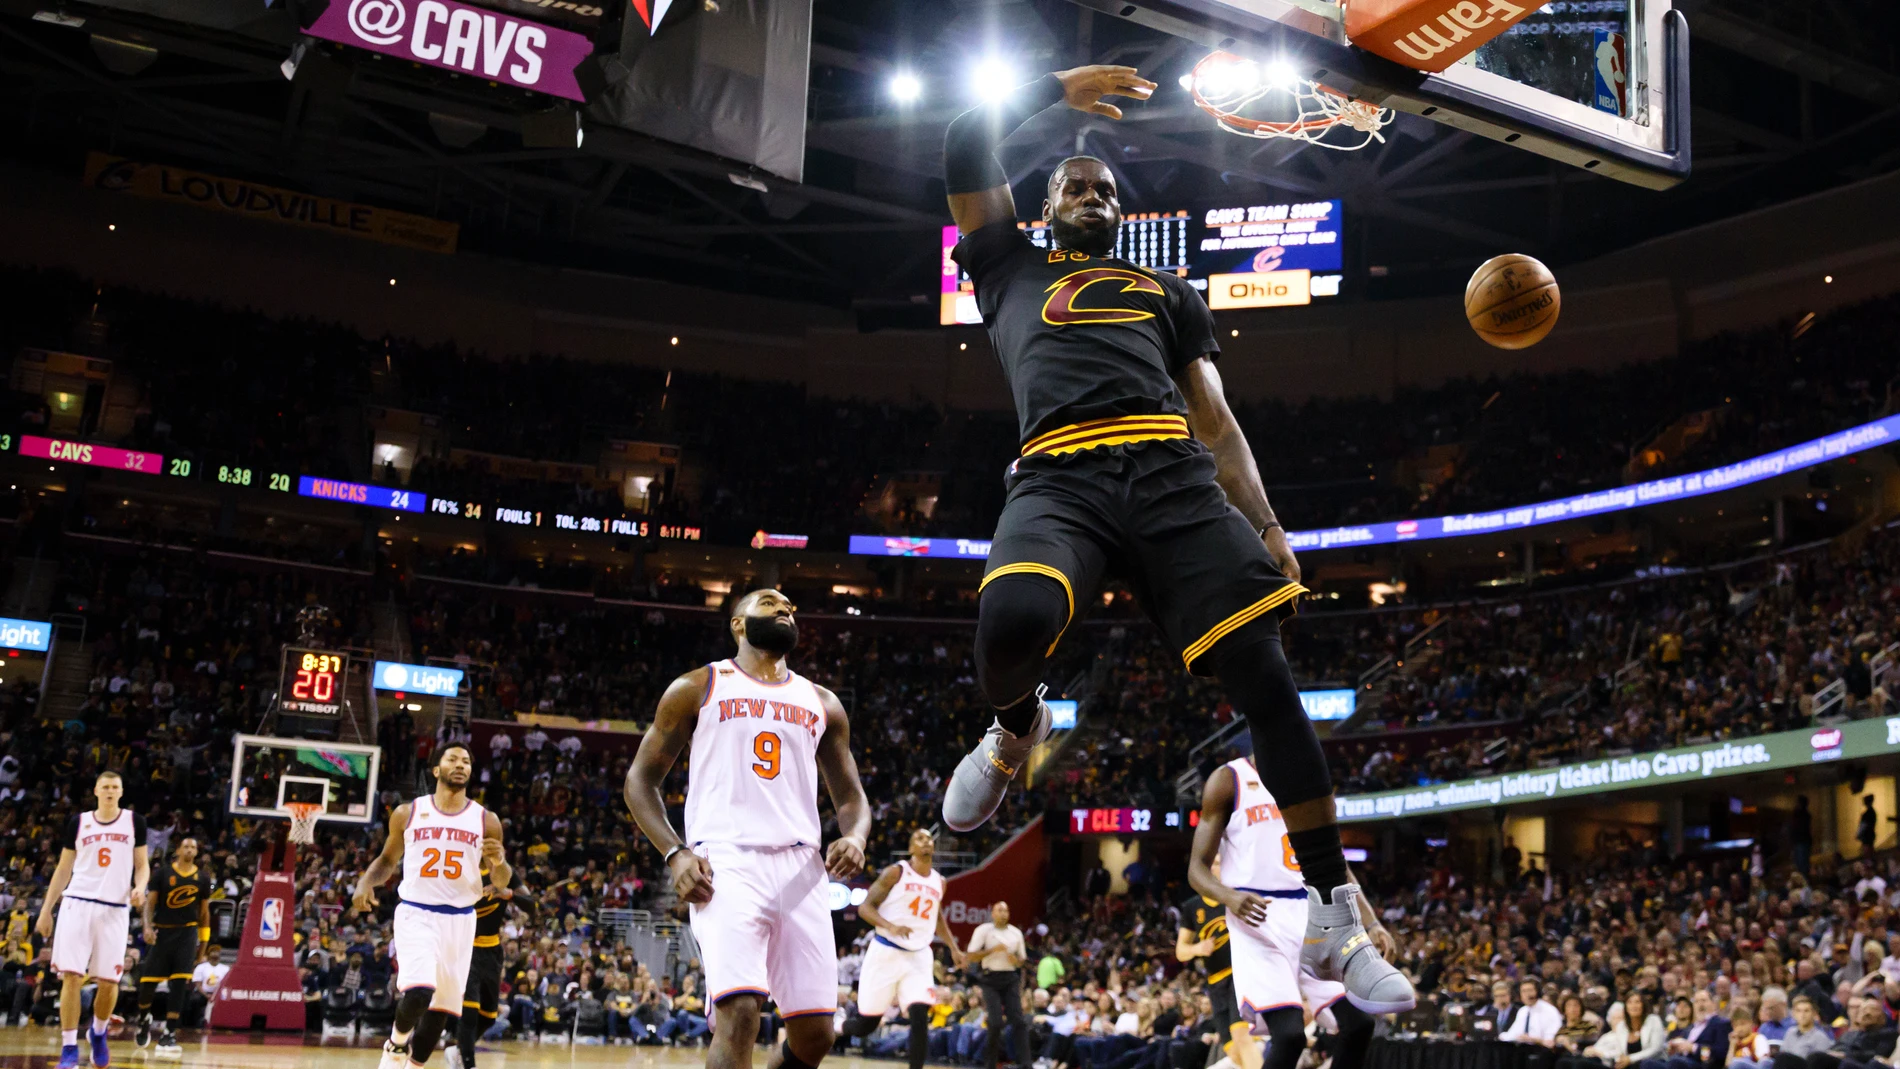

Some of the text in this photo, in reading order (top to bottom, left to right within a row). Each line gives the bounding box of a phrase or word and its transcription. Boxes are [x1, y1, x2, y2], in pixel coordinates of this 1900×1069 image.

[1393, 0, 1526, 60] Farm
[347, 0, 547, 85] @CAVS
[1599, 95, 1617, 111] NBA
[160, 169, 372, 232] LOUDVILLE
[1206, 201, 1333, 225] CAVS TEAM SHOP
[1229, 282, 1288, 299] Ohio
[1491, 288, 1554, 328] SPALDING
[49, 440, 191, 477] CAVS 32 20
[218, 465, 290, 493] 8:38 2Q
[311, 478, 409, 510] KNICKS 24
[1442, 513, 1505, 533] Redeem
[1505, 508, 1534, 525] any
[1535, 488, 1636, 520] non-winning
[1637, 477, 1684, 501] ticket
[1685, 473, 1703, 492] at
[431, 498, 482, 520] FG% 34
[496, 507, 542, 527] FOULS 1
[602, 517, 609, 533] 1
[611, 520, 639, 536] FULL
[639, 521, 648, 537] 5
[659, 524, 700, 540] 8:11 PM
[1320, 527, 1374, 549] prizes.
[0, 623, 42, 648] ight
[301, 653, 341, 673] 8:37
[292, 669, 333, 701] 20
[411, 671, 455, 694] Light
[298, 702, 341, 715] TISSOT
[719, 698, 819, 738] NEW YORK
[752, 731, 781, 781] 9
[1334, 743, 1771, 818] Turn any non-winning lottery ticket into Cavs prizes.
[1092, 808, 1121, 832] CLE
[1131, 809, 1151, 831] 32
[82, 834, 103, 847] NEW
[414, 827, 479, 848] NEW YORK
[97, 847, 111, 867] 6
[420, 847, 464, 880] 25
[908, 895, 933, 920] 42
[231, 989, 303, 1003] NBA LEAGUE PASS
